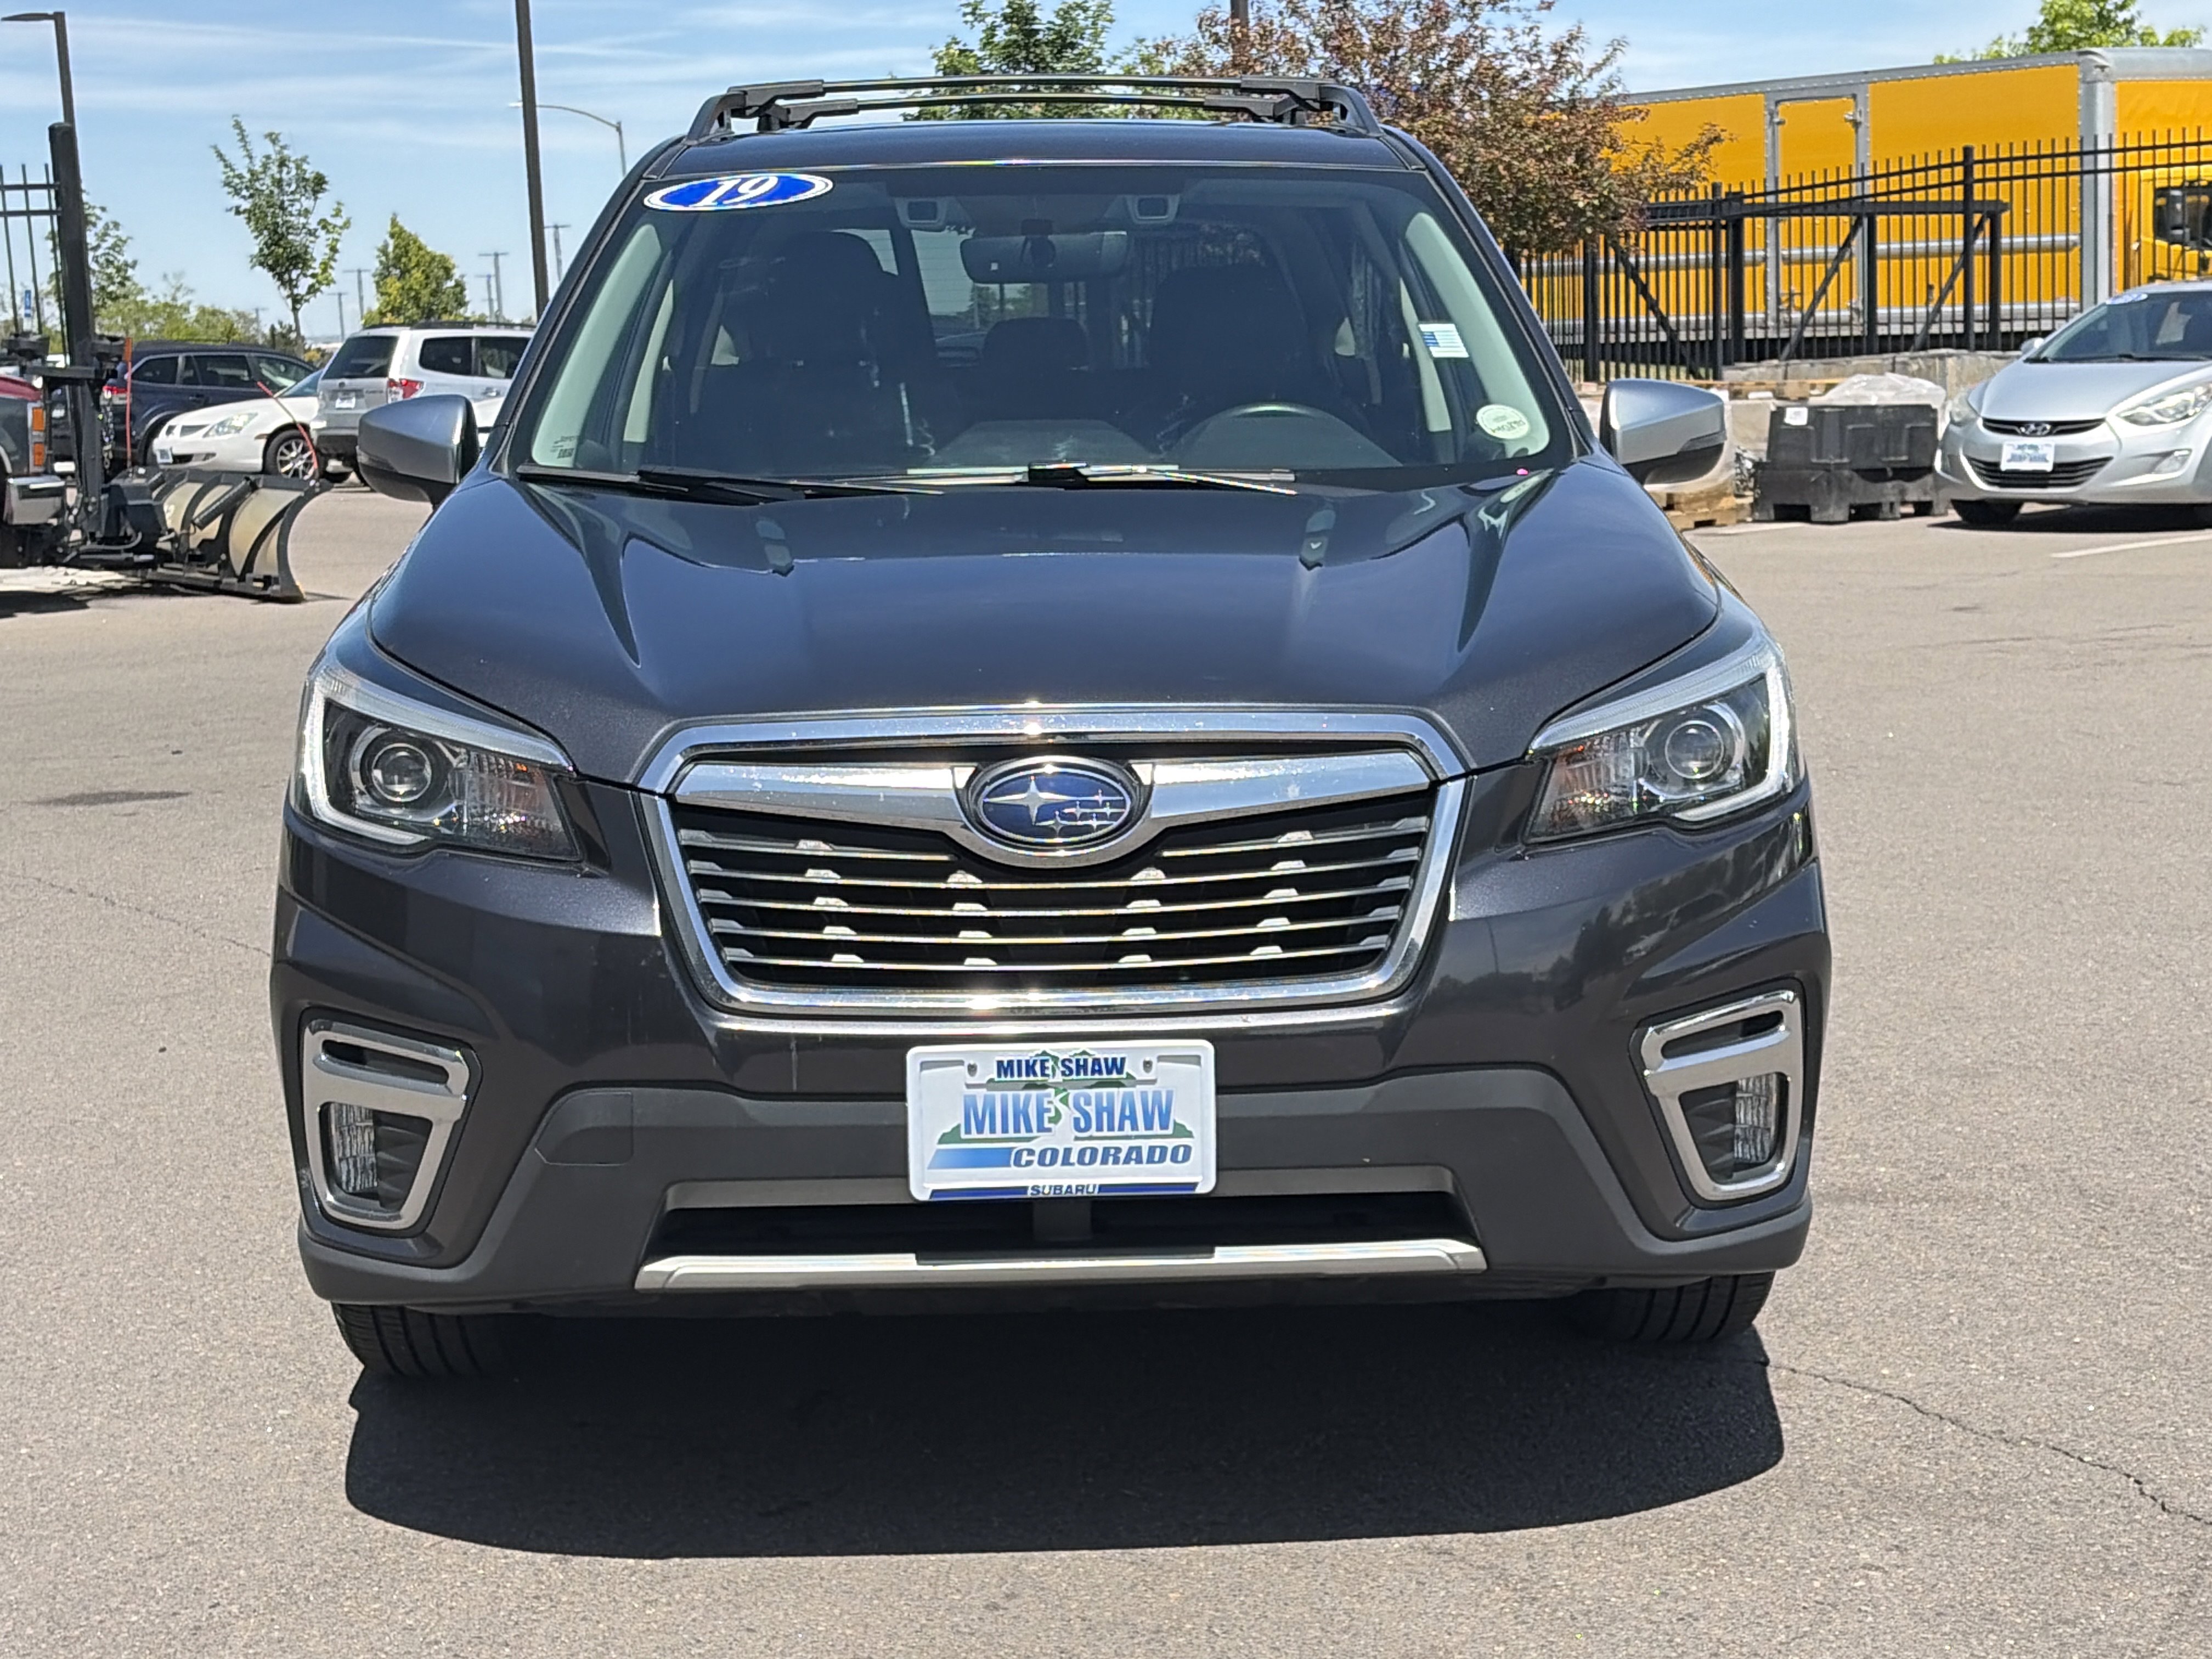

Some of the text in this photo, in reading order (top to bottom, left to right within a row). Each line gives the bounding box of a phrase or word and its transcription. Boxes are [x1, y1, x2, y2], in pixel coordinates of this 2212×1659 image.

[689, 176, 778, 207] 19
[996, 1057, 1127, 1079] MIKE SHAW
[963, 1089, 1175, 1135] MIKE SHAW
[1013, 1144, 1193, 1167] COLORADO
[1030, 1184, 1097, 1197] SUBARU
